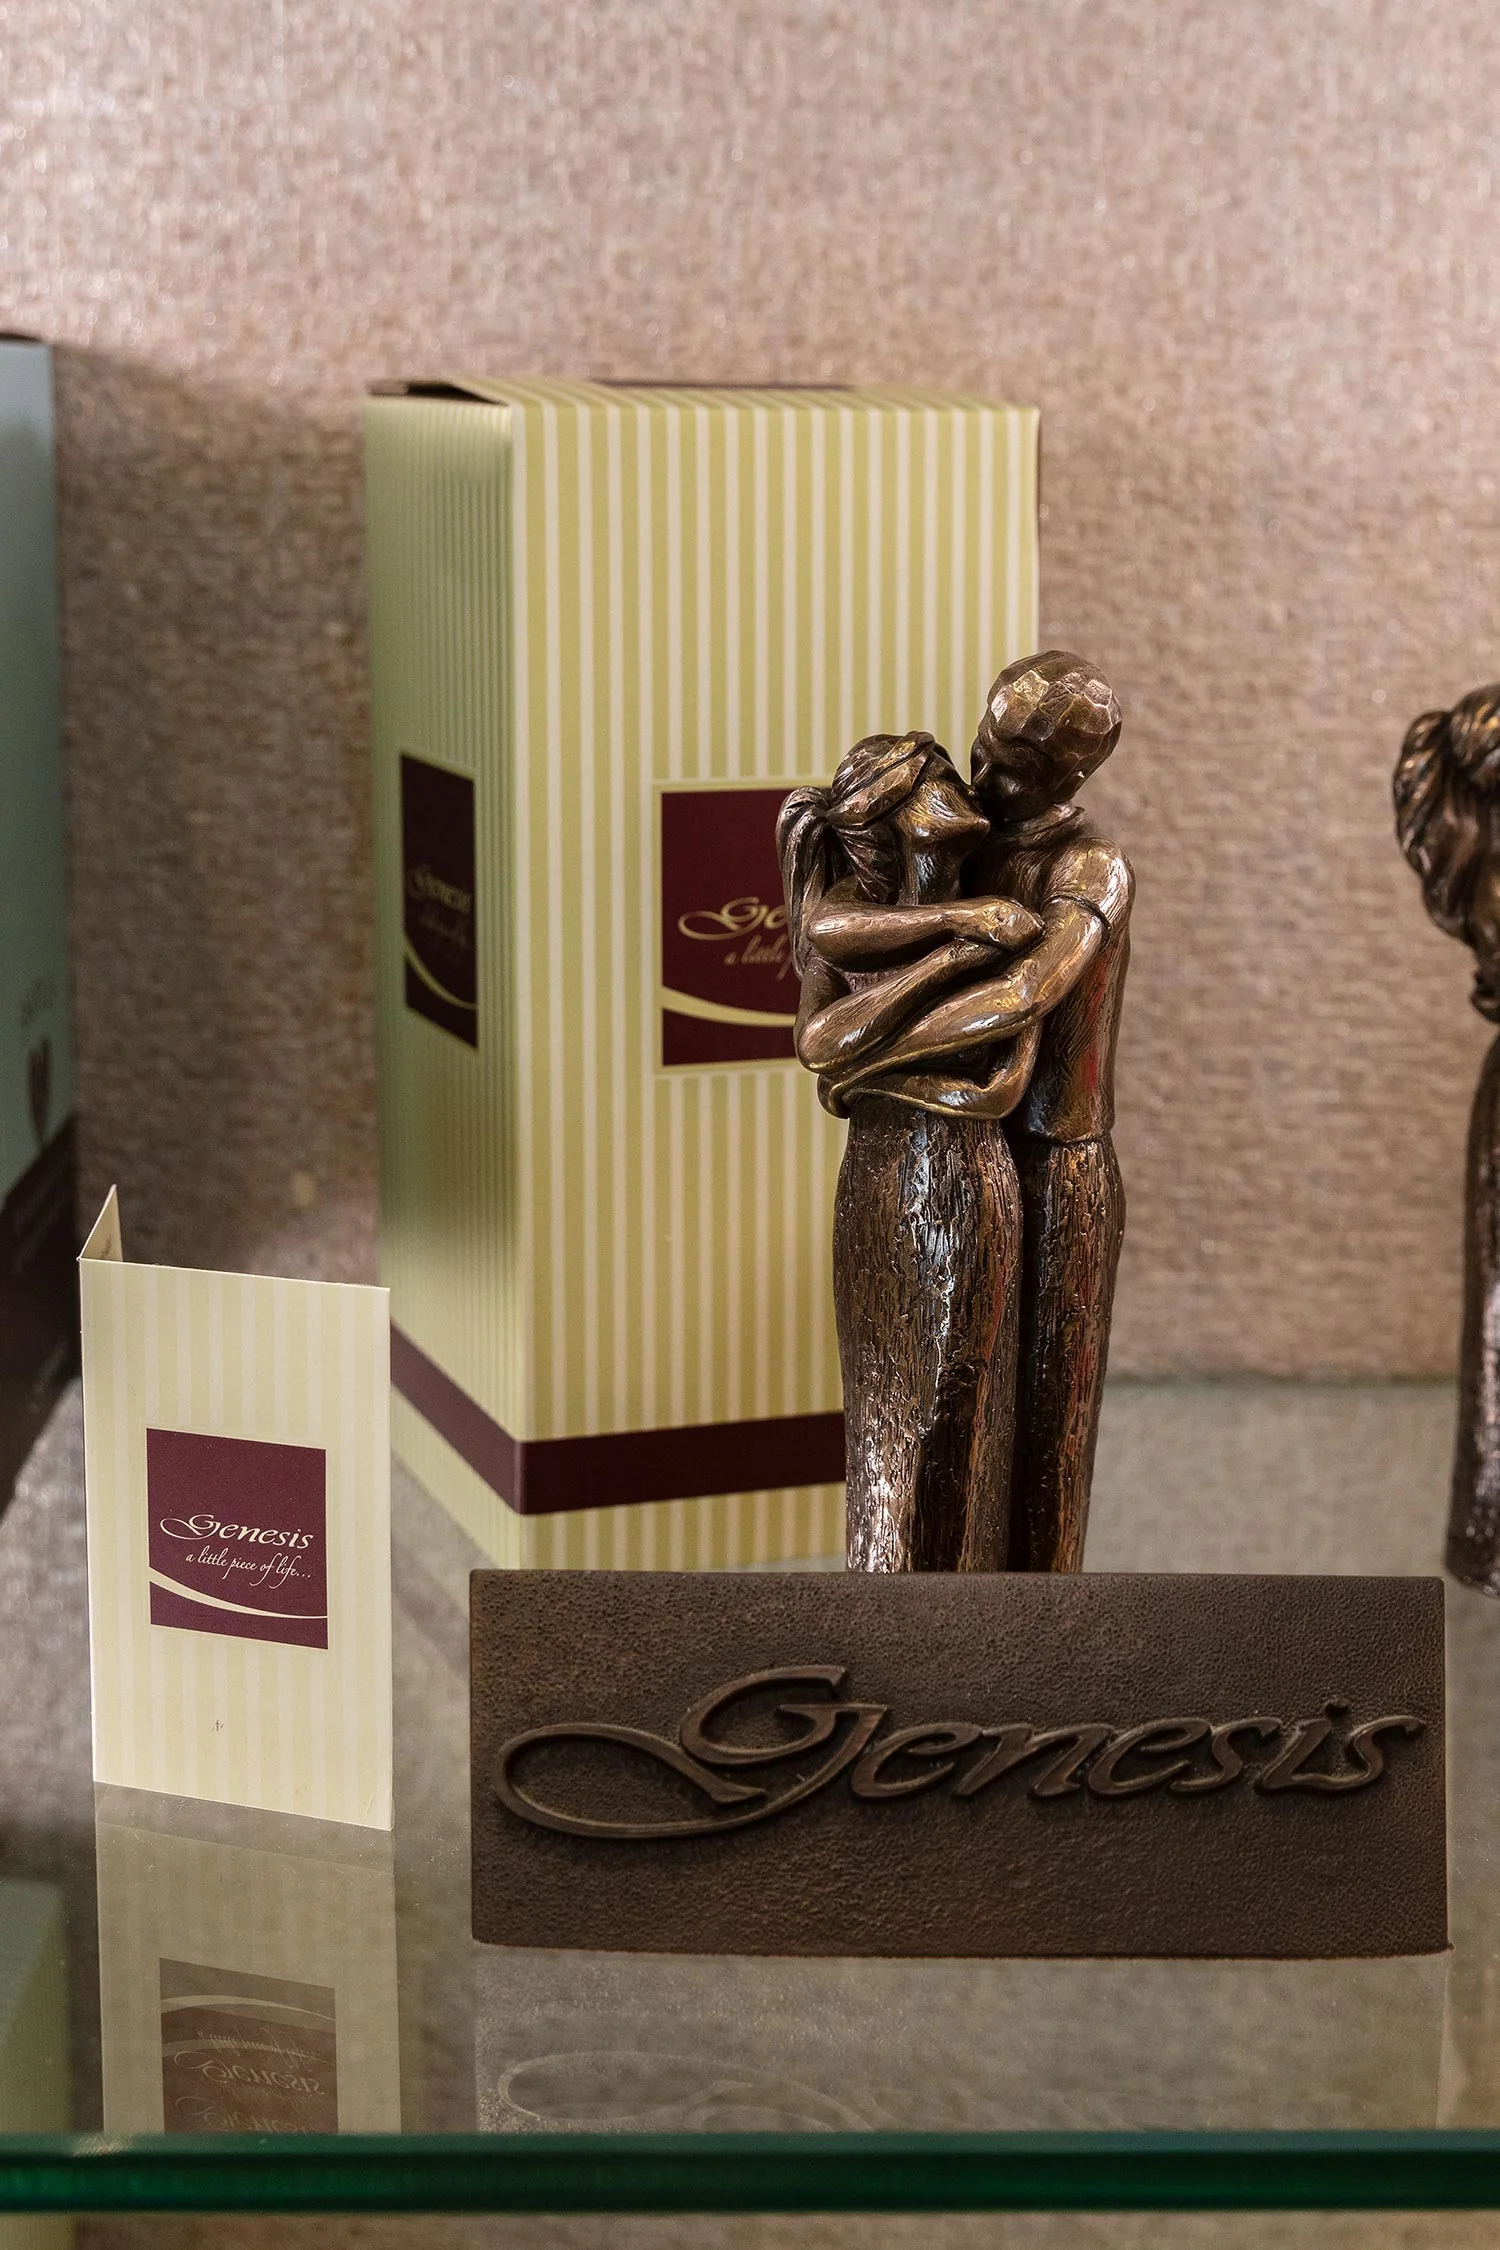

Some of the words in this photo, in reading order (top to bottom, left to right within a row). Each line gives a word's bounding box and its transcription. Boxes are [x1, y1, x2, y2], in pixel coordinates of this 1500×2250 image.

[160, 1514, 314, 1549] Genesis
[185, 1553, 196, 1562] a
[197, 1544, 228, 1567] little
[222, 1557, 258, 1580] piece
[250, 1552, 283, 1586] of
[492, 1664, 1428, 1839] Genesis
